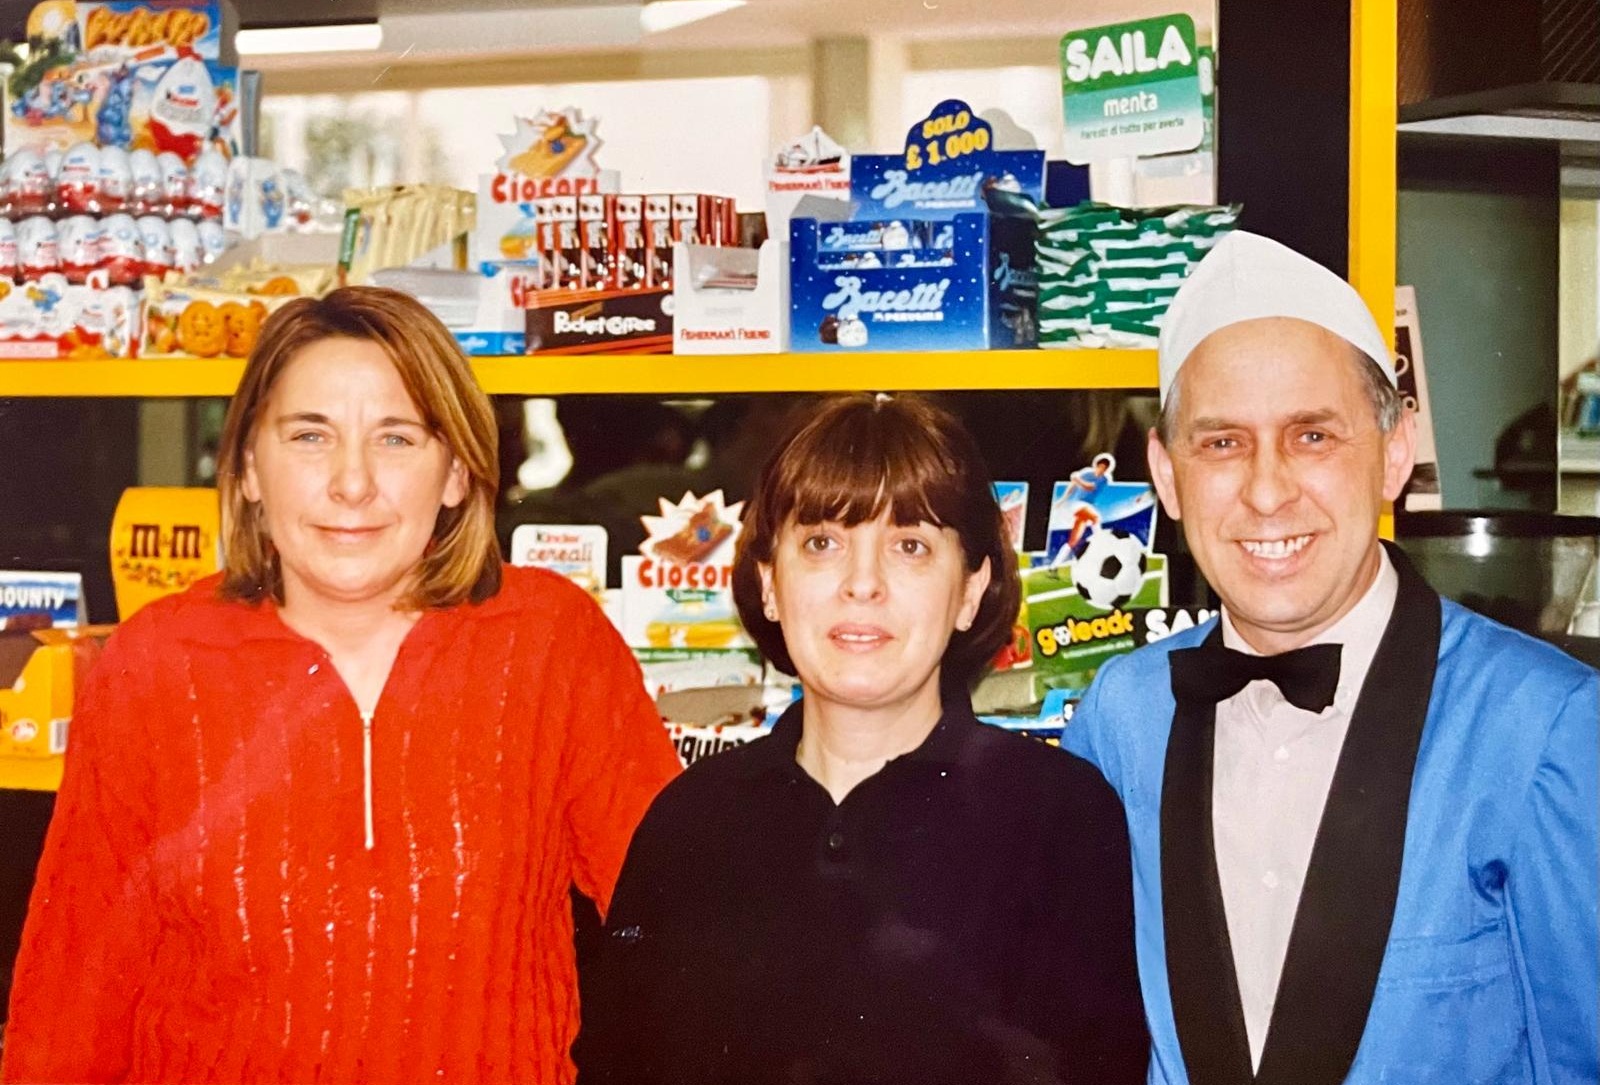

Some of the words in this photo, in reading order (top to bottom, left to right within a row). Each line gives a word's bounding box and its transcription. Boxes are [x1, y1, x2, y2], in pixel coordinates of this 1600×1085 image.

[1066, 25, 1192, 82] SAILA
[1103, 91, 1158, 116] menta
[922, 110, 970, 139] SOLO
[1143, 121, 1157, 132] per
[906, 144, 922, 171] £
[926, 128, 989, 166] 1.000
[492, 173, 598, 203] Ciocori
[871, 169, 984, 209] Bacetti
[822, 275, 951, 320] Bacetti
[605, 316, 656, 336] Coffee
[527, 542, 593, 562] cereali
[0, 586, 65, 610] OUNTY
